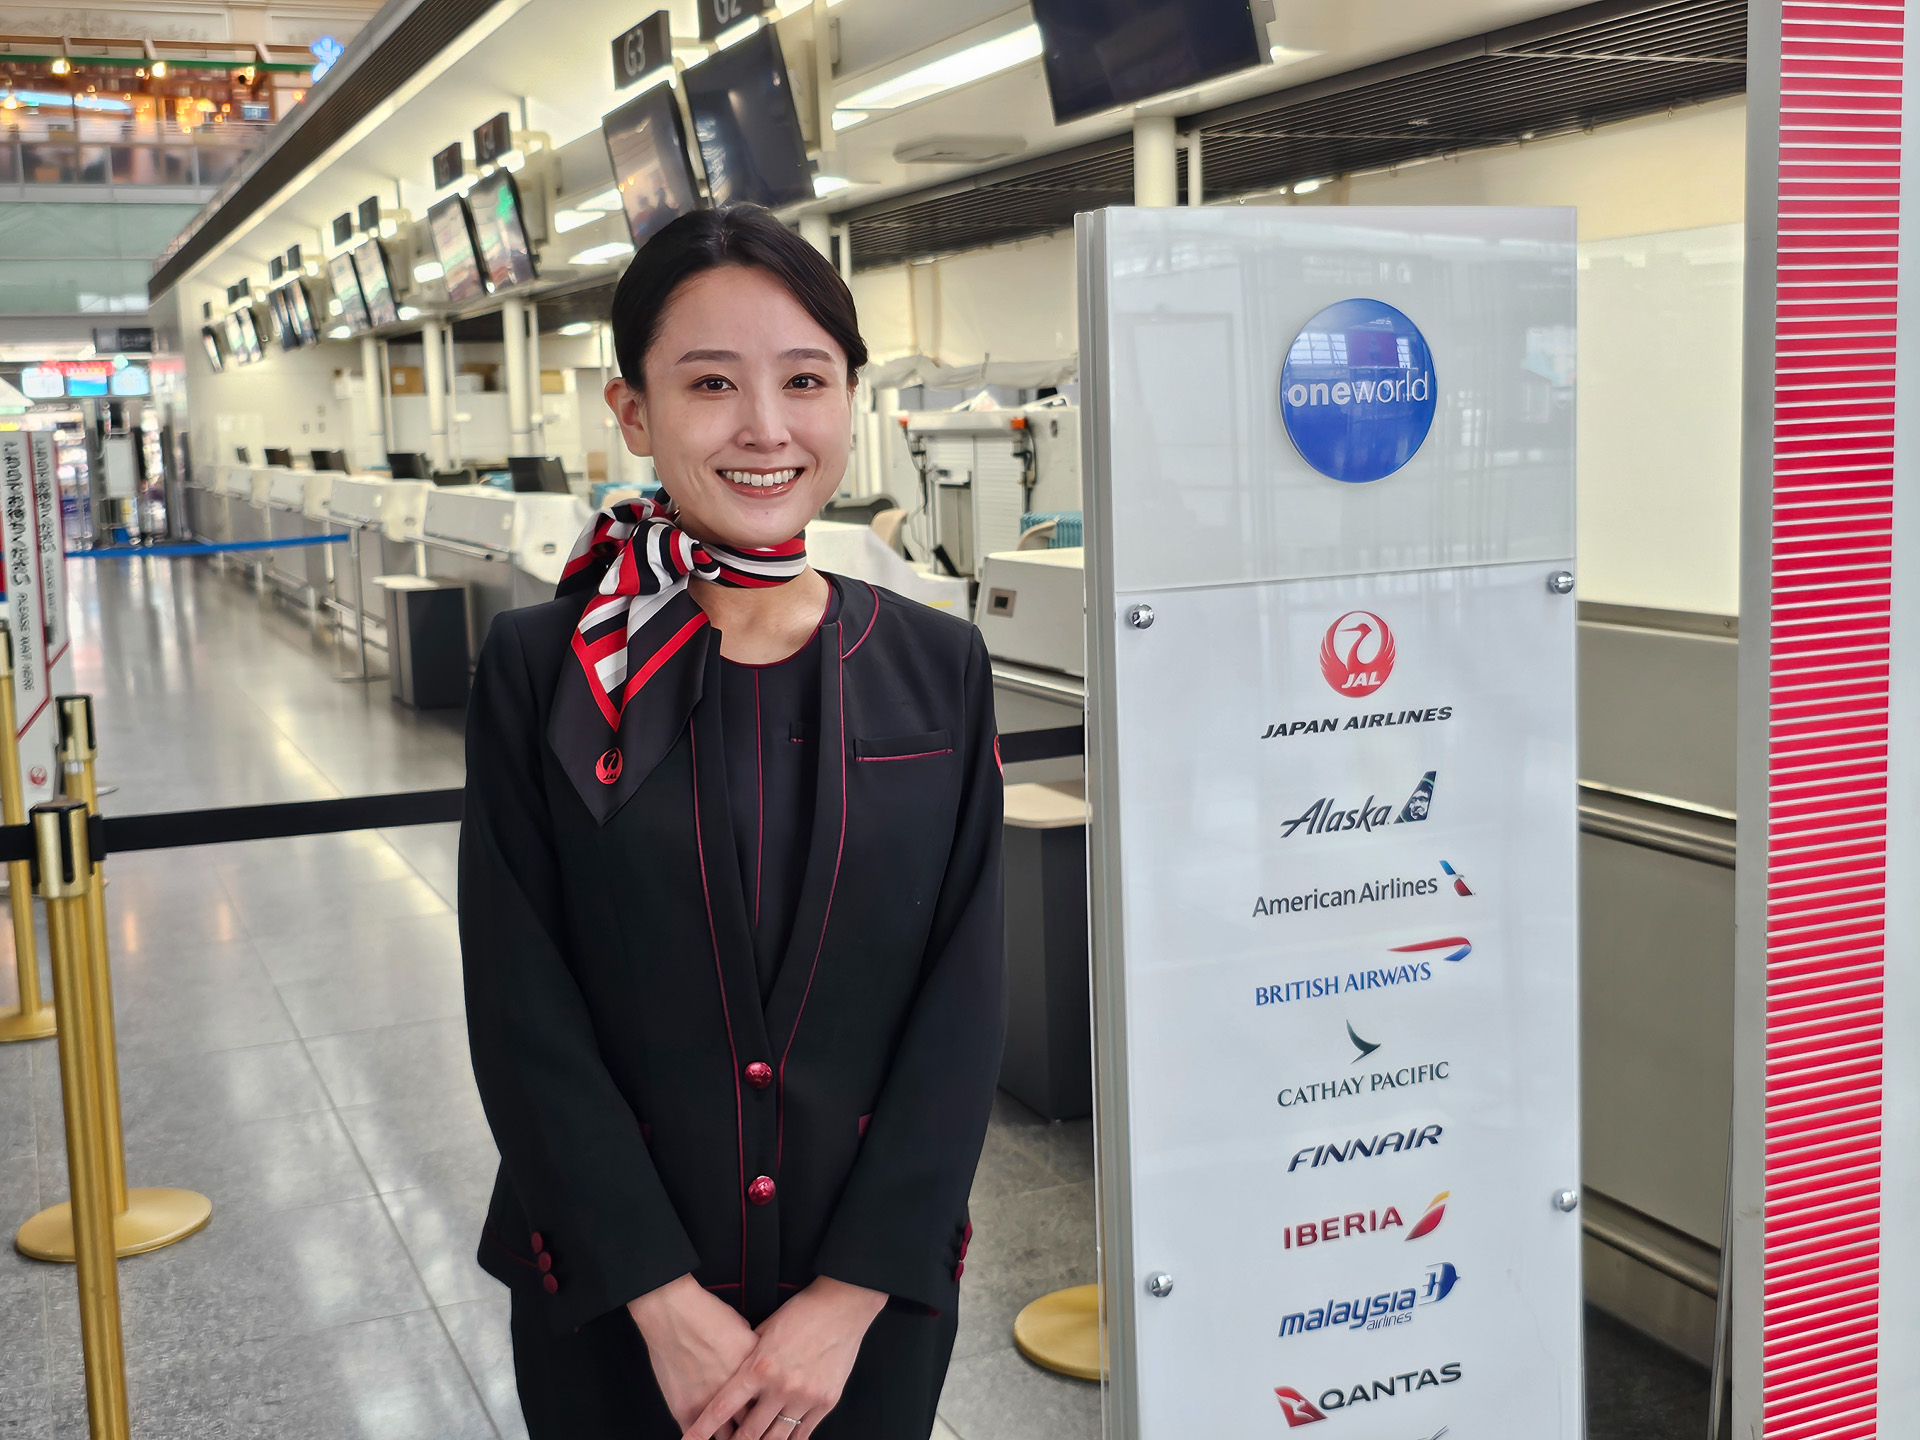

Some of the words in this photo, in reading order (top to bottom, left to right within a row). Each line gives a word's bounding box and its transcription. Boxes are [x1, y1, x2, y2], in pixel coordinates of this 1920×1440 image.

[624, 28, 646, 77] G3
[1287, 370, 1429, 408] oneworld
[1341, 671, 1381, 689] JAL
[1261, 717, 1339, 740] JAPAN
[1343, 706, 1453, 731] AIRLINES
[1280, 794, 1393, 838] Alaska
[1252, 888, 1356, 918] American
[1358, 877, 1438, 904] Airlines
[1255, 975, 1339, 1006] BRITISH
[1344, 961, 1431, 992] AIRWAYS
[1276, 1074, 1365, 1107] CATHAY
[1370, 1061, 1449, 1091] PACIFIC
[1287, 1123, 1443, 1173] FINNAIR
[1283, 1205, 1404, 1250] IBERIA
[1278, 1288, 1416, 1337] malaysia
[1366, 1311, 1413, 1331] airlines
[1318, 1361, 1462, 1411] QANTAS
